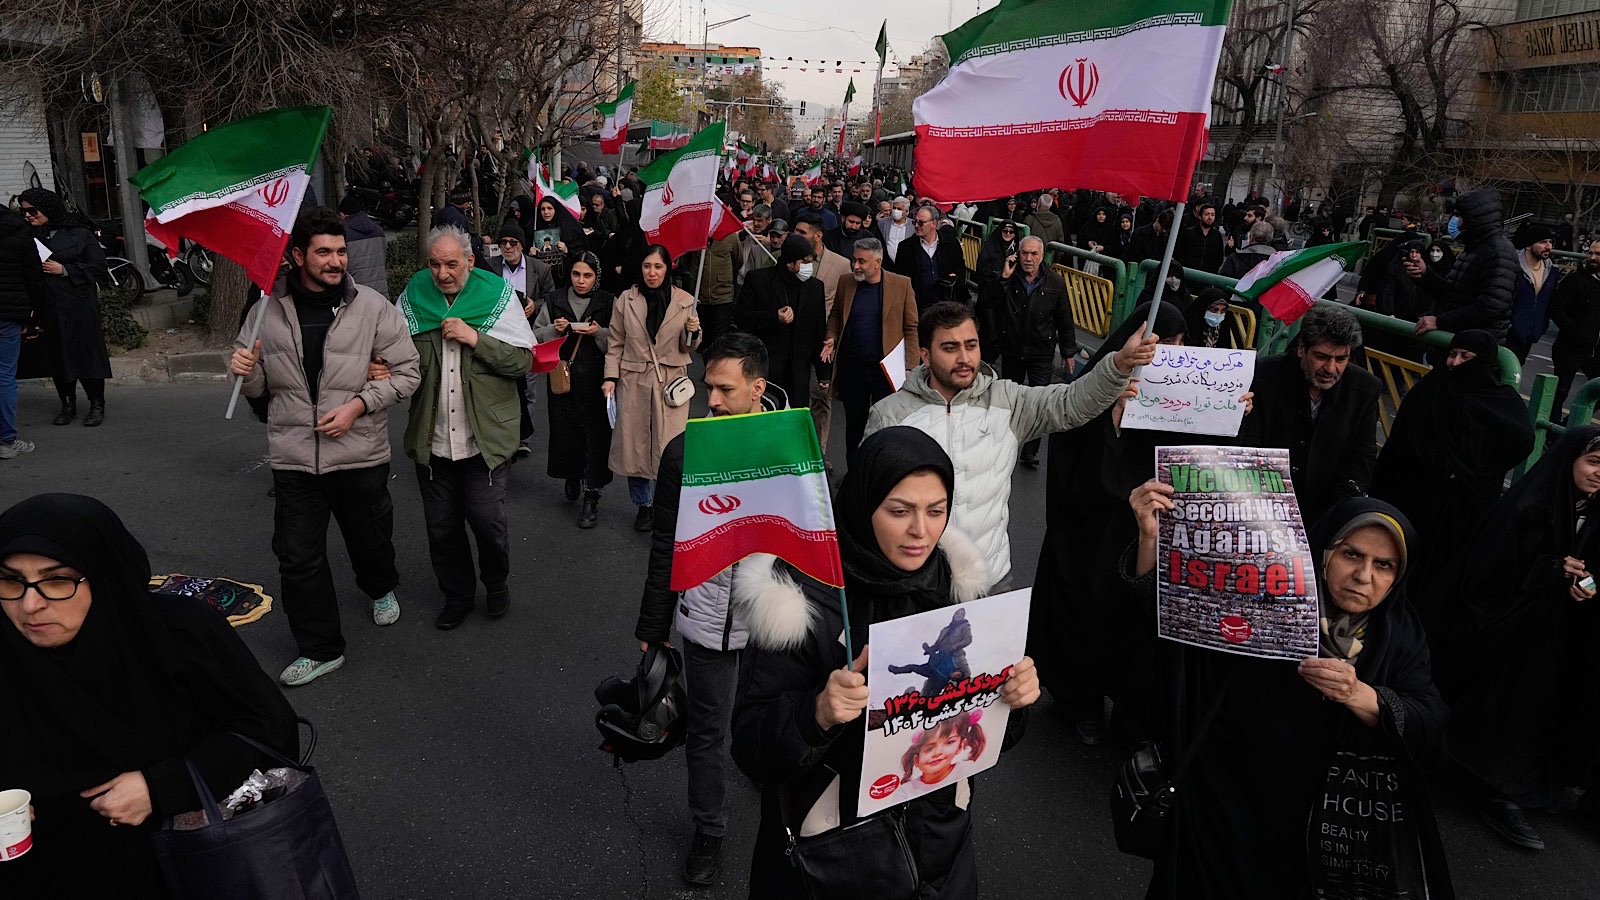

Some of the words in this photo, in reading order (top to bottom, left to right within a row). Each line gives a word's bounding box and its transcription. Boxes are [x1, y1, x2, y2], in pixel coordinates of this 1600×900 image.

[1525, 26, 1556, 58] BANK
[1151, 349, 1174, 367] باش
[1196, 359, 1211, 370] می
[1159, 396, 1191, 411] مردود
[1170, 464, 1261, 494] Victory
[1262, 466, 1287, 493] in
[1171, 499, 1253, 522] Second
[1254, 499, 1291, 522] War
[1171, 523, 1300, 554] Against
[1169, 550, 1307, 596] Israel
[884, 690, 926, 716] ۱۳۶۰
[883, 710, 926, 737] ۱۴۰۴
[1326, 766, 1399, 792] PANTS
[1323, 793, 1404, 823] HOUSE
[1321, 822, 1369, 842] BEAUTY
[1320, 839, 1332, 852] IS
[1335, 843, 1349, 855] IN
